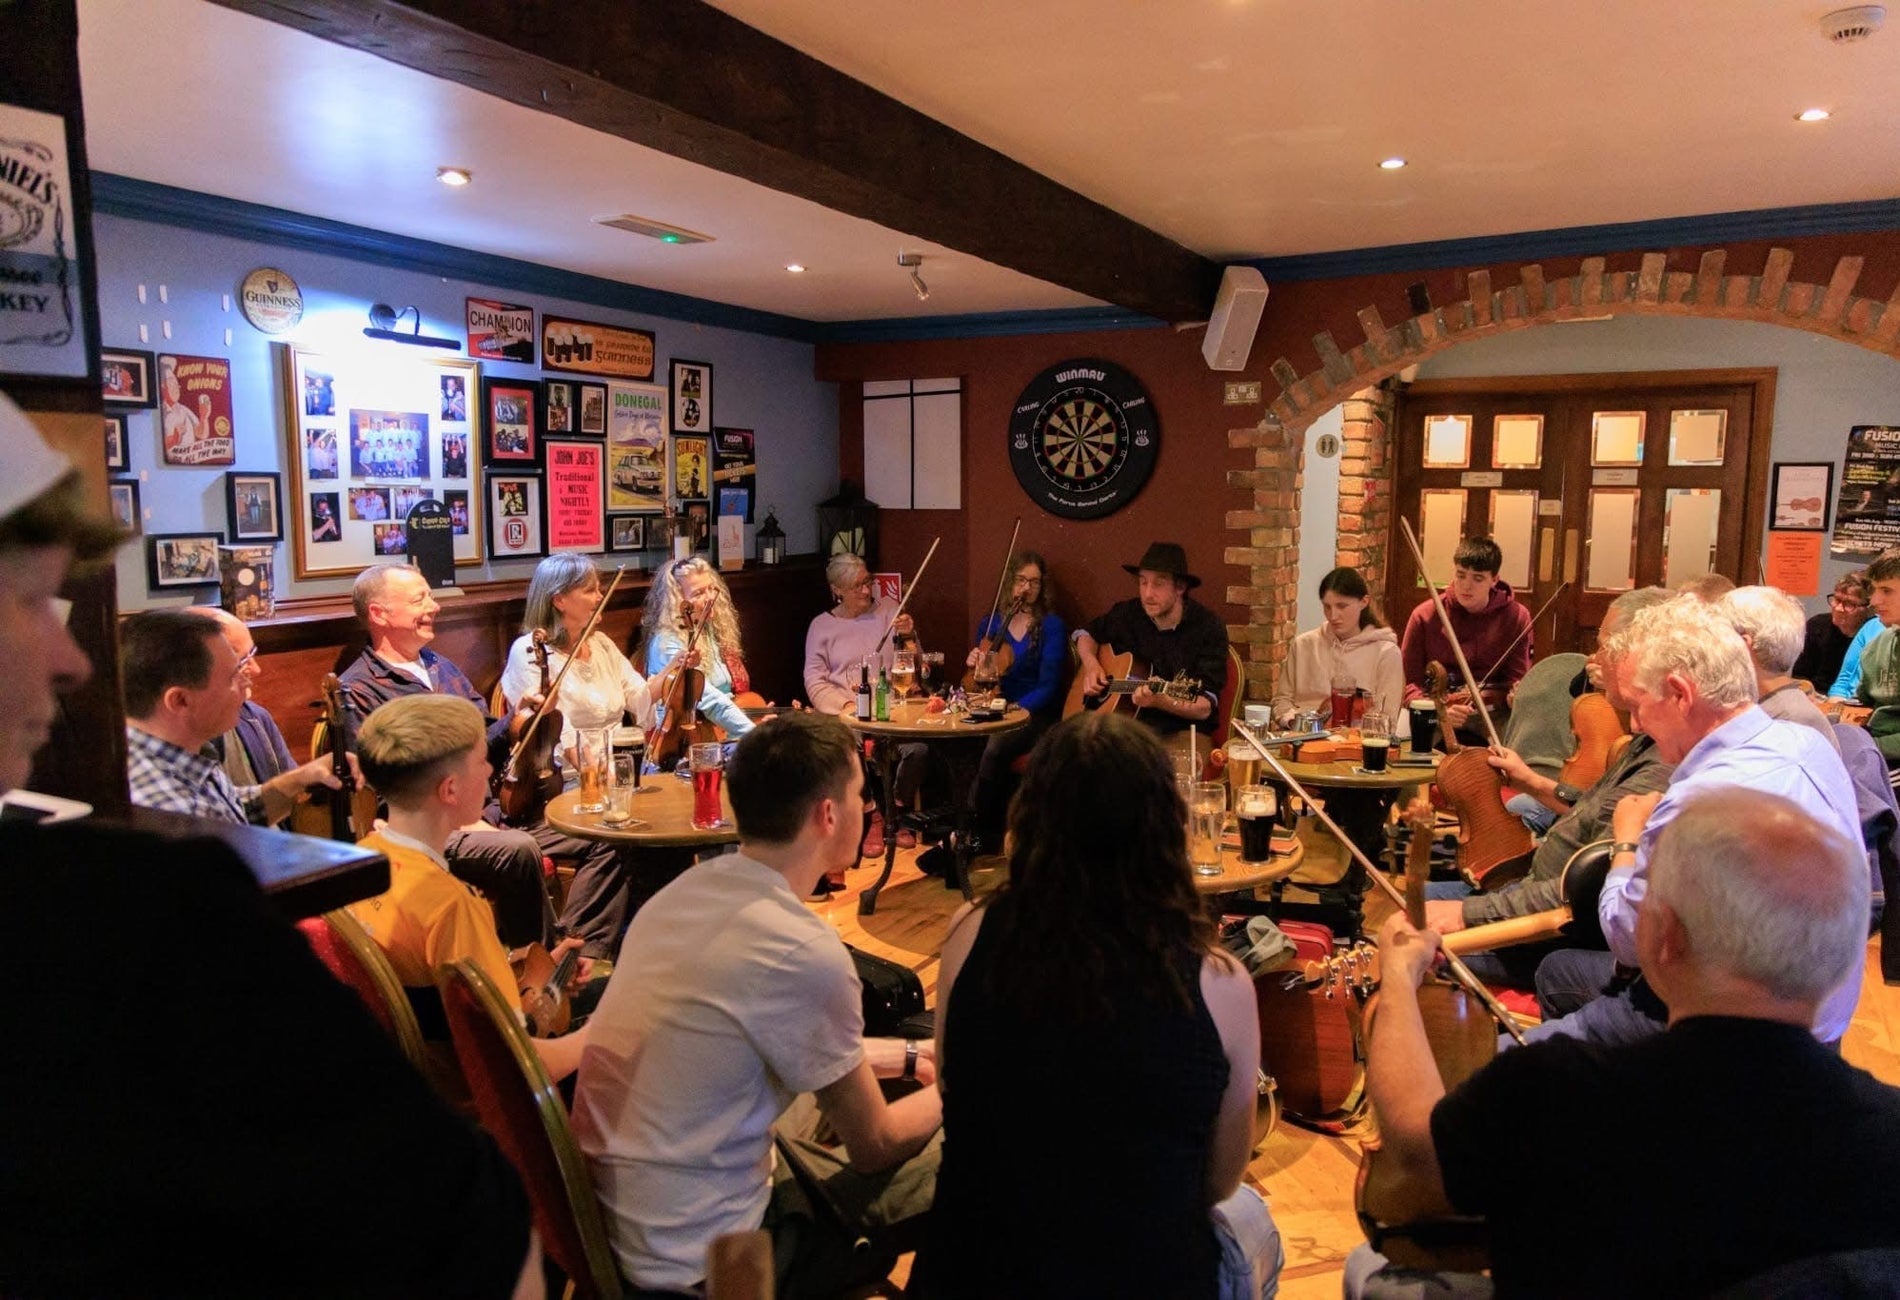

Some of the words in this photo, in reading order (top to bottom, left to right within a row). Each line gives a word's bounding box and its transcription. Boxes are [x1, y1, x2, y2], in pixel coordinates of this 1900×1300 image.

[245, 290, 301, 308] GUINNESS
[177, 362, 204, 378] KNOW
[186, 378, 223, 391] ONIONS
[615, 392, 662, 410] DONEGAL
[555, 449, 573, 465] JOHN
[555, 471, 595, 482] Traditional
[560, 496, 590, 507] NIGHTLY
